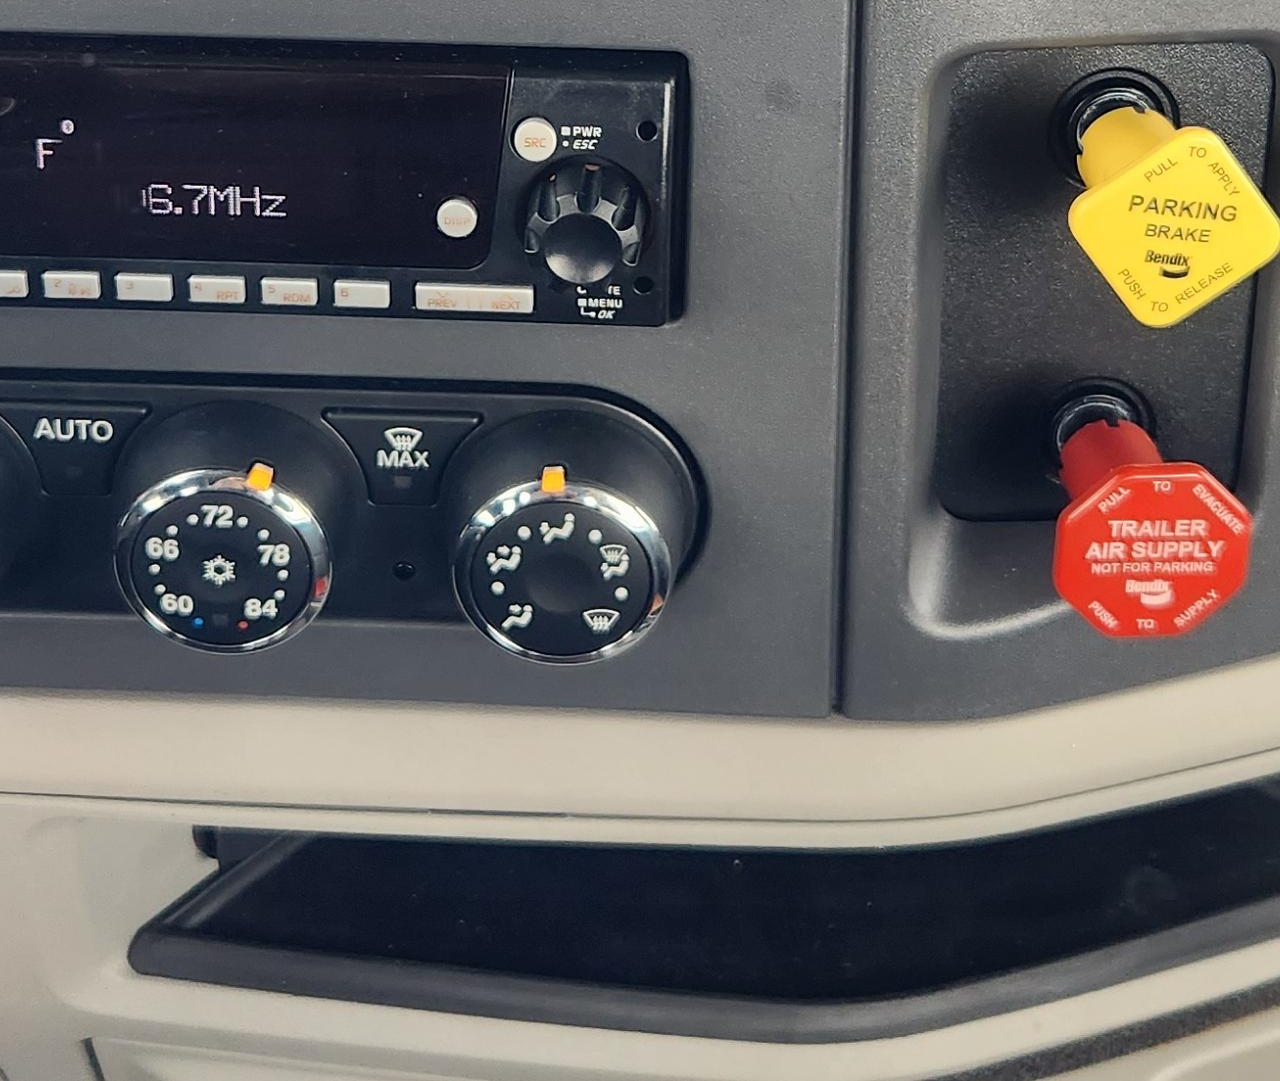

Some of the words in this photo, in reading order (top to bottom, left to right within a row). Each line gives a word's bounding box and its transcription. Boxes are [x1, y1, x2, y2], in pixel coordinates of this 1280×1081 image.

[572, 126, 602, 138] PWR
[524, 137, 546, 148] SRC
[572, 140, 599, 150] ESC
[1144, 158, 1178, 183] PULL
[1188, 146, 1207, 158] TO
[1208, 161, 1240, 197] APPLY
[142, 184, 287, 217] 6.7MHz
[1128, 194, 1238, 222] PARKING
[1144, 224, 1212, 243] BRAKE
[1144, 250, 1190, 267] Bendix
[1117, 268, 1146, 300] PUSH
[1150, 301, 1169, 312] TO
[1175, 262, 1233, 304] RELEASE
[428, 298, 456, 308] PREV
[491, 301, 520, 310] NEXT
[588, 298, 623, 308] MENU
[598, 310, 616, 319] OK
[33, 418, 114, 443] AUTO
[376, 450, 431, 469] MAX
[200, 504, 233, 528] 72
[1097, 485, 1131, 514] PULL
[1153, 480, 1172, 492] TO
[1192, 484, 1246, 536] EVACUATE
[1108, 520, 1208, 538] TRAILER
[146, 536, 180, 560] 66
[258, 544, 290, 566] 78
[1084, 542, 1126, 560] AIR
[1131, 540, 1225, 558] SUPPLY
[1091, 562, 1121, 574] NOT
[1122, 562, 1151, 574] FOR
[1154, 560, 1214, 574] PARKING
[1126, 579, 1171, 594] Bendix
[160, 593, 195, 616] 60
[244, 598, 278, 620] 84
[1087, 600, 1120, 630] PUSH
[1136, 618, 1155, 630] TO
[1174, 589, 1220, 628] SUPPLY
